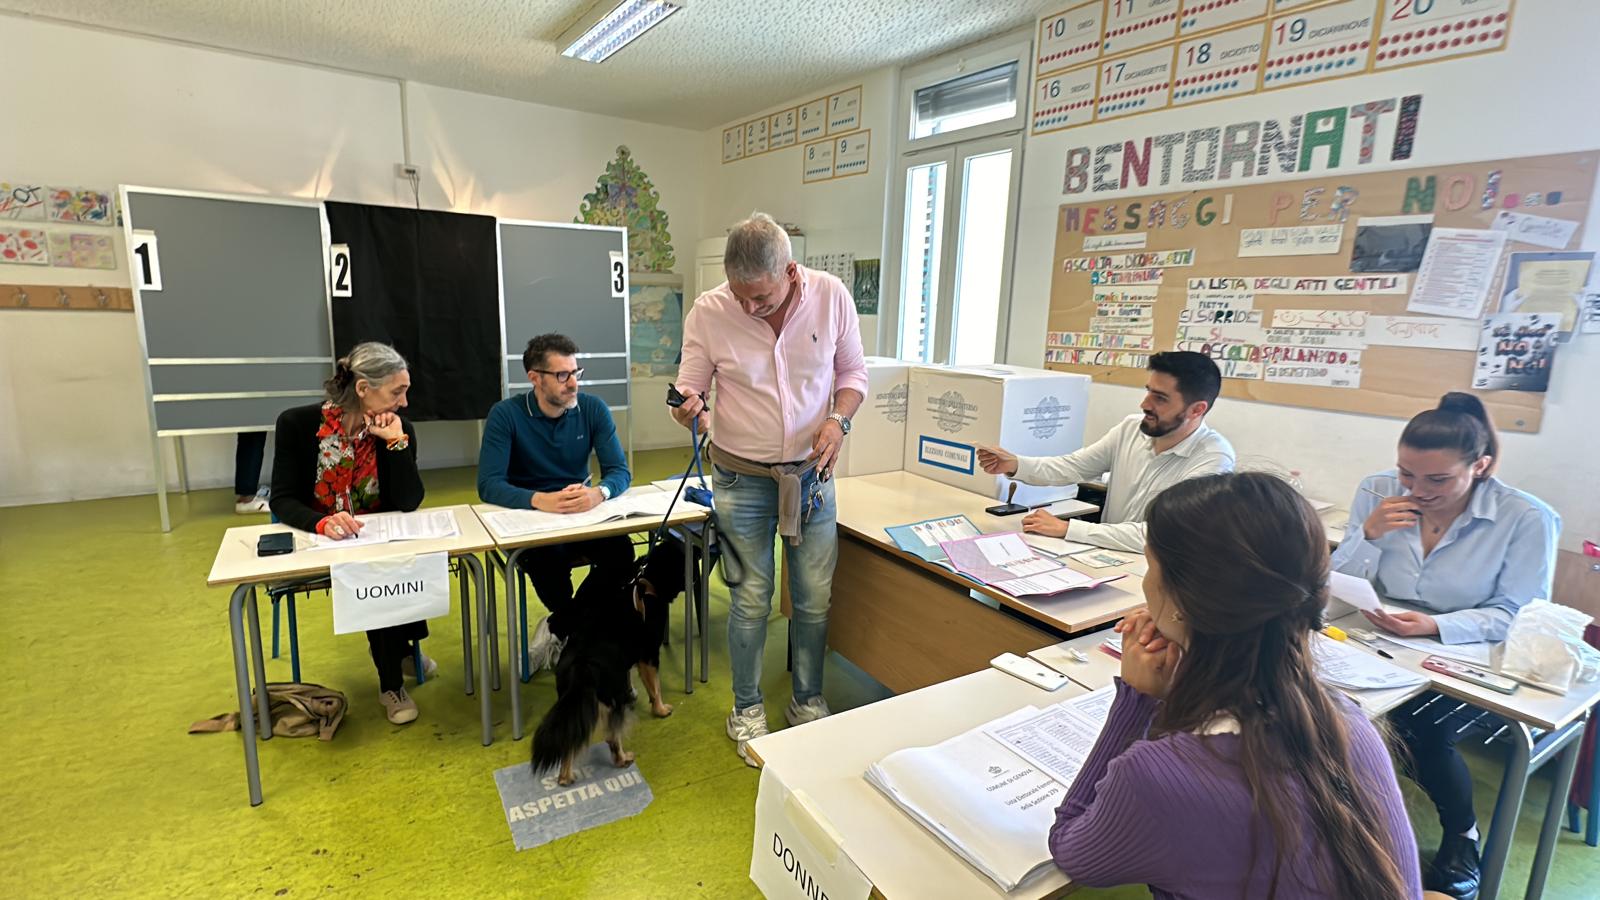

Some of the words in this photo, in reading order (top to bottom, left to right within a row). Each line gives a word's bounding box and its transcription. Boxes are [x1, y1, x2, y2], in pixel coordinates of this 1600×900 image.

[1047, 18, 1066, 41] 10
[1274, 18, 1308, 45] 19
[1185, 42, 1213, 67] 18
[1104, 63, 1127, 85] 17
[1041, 80, 1061, 100] 16
[802, 107, 808, 121] 6
[833, 97, 839, 111] 7
[760, 121, 766, 133] 3
[774, 117, 780, 128] 4
[786, 113, 793, 126] 5
[809, 148, 815, 160] 8
[840, 140, 847, 153] 9
[1062, 94, 1423, 195] BENTORNATI
[1064, 194, 1233, 235] MESSAGGI
[1271, 186, 1359, 226] PER
[134, 242, 153, 285] 1
[334, 253, 349, 291] 2
[613, 261, 624, 293] 3
[1189, 279, 1206, 290] LA
[1209, 278, 1248, 290] LISTA
[1254, 278, 1290, 290] DEGLI
[1294, 279, 1328, 291] ATTI
[1334, 277, 1399, 290] GENTILI
[356, 580, 424, 600] UOMINI
[509, 783, 604, 823] ASPETTA
[604, 771, 642, 792] QUI
